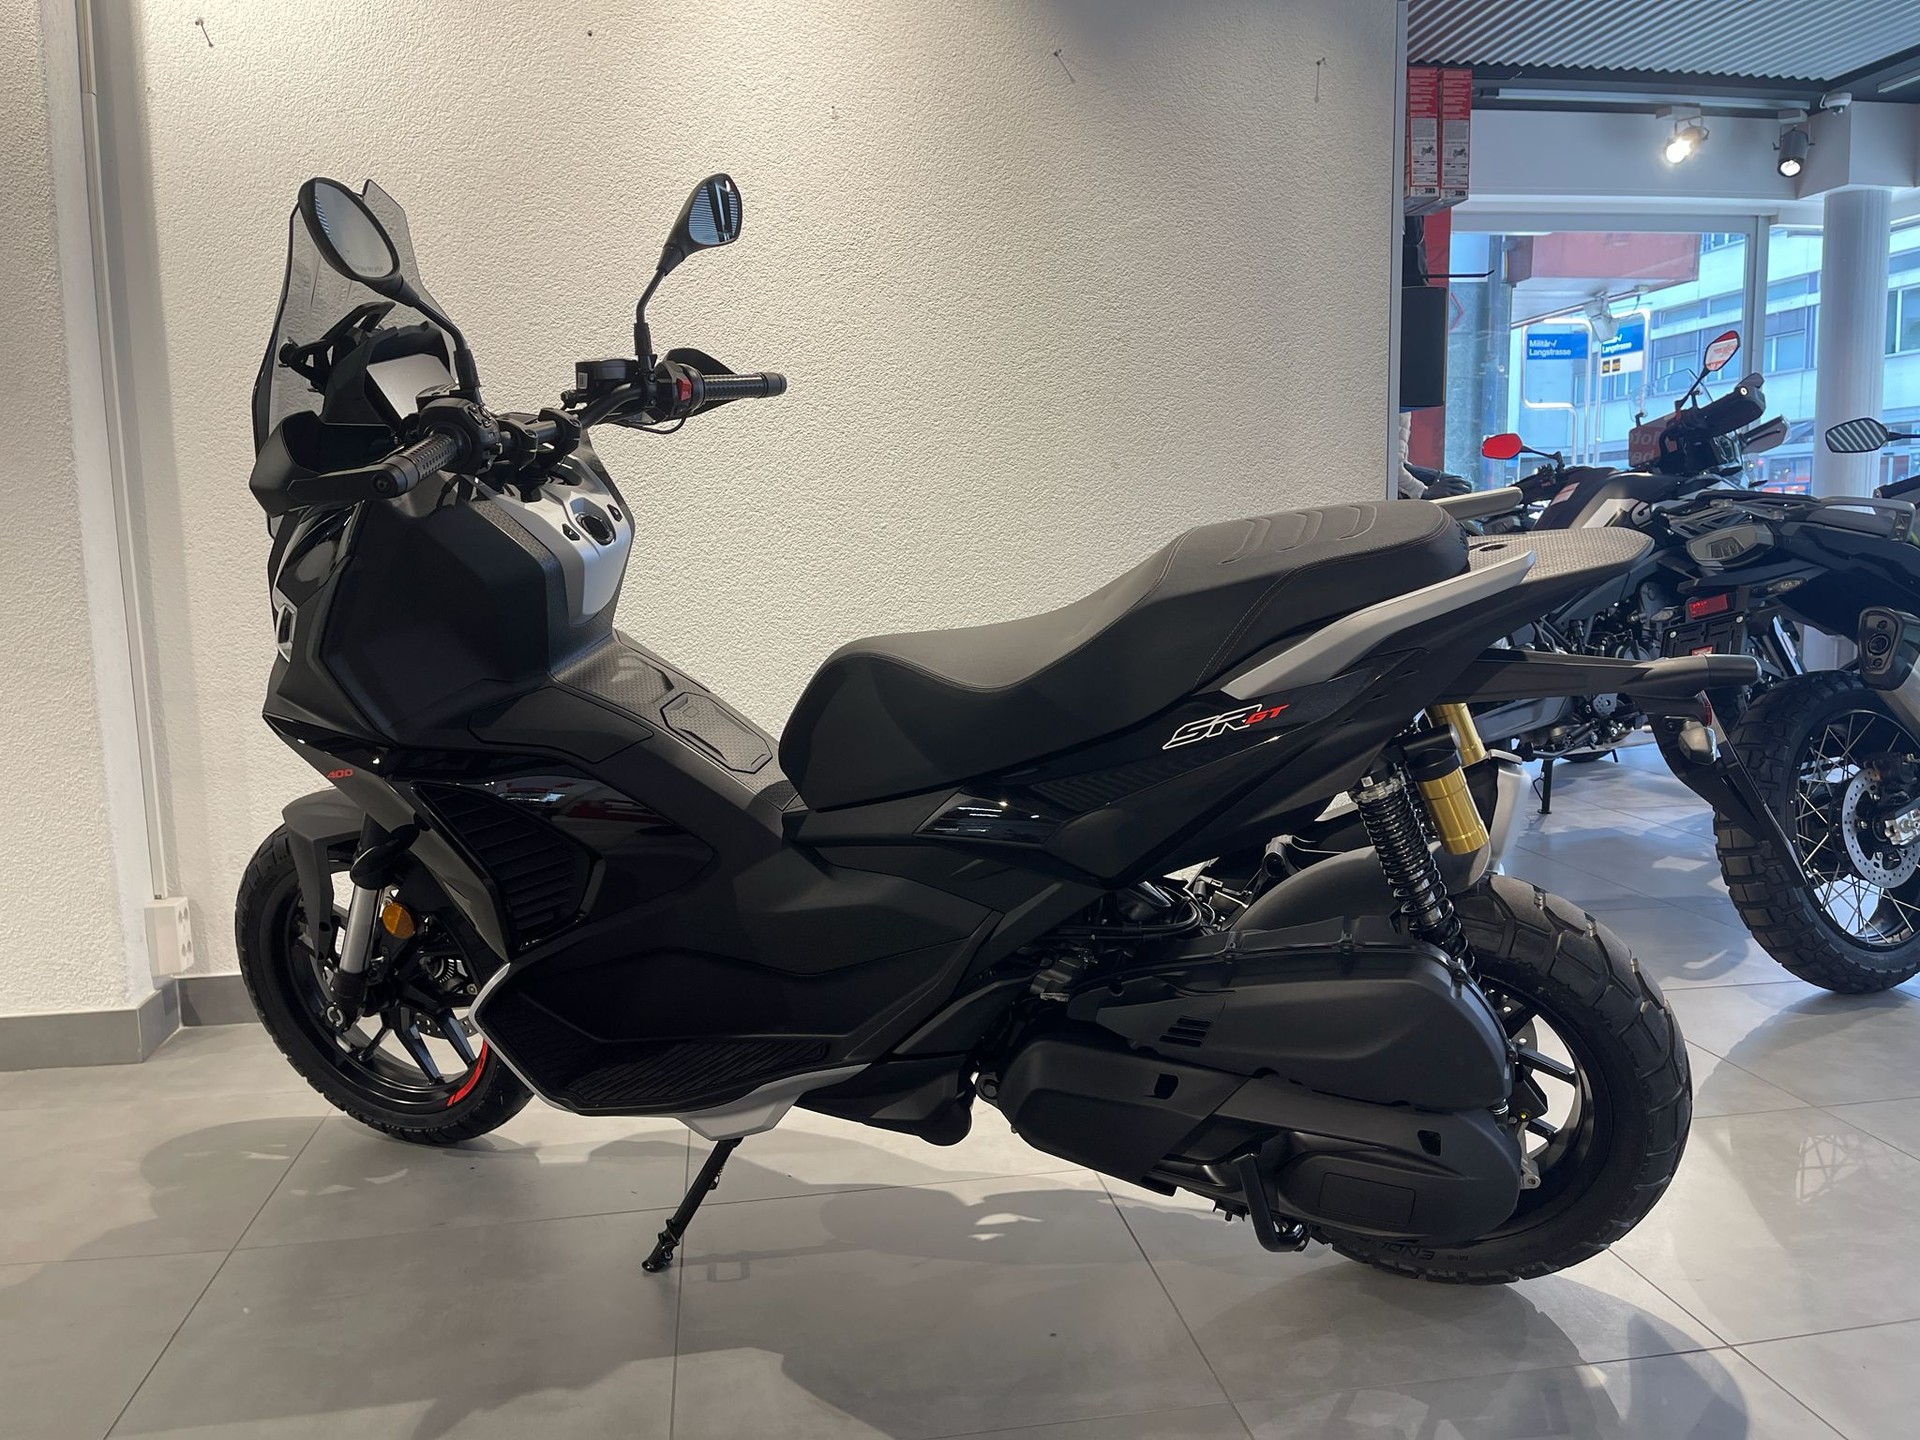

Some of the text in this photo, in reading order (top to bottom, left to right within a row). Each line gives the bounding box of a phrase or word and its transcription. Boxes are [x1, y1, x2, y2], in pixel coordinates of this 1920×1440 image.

[1529, 348, 1571, 357] Langstrasse
[1162, 703, 1290, 750] SR GT
[327, 769, 353, 778] 400
